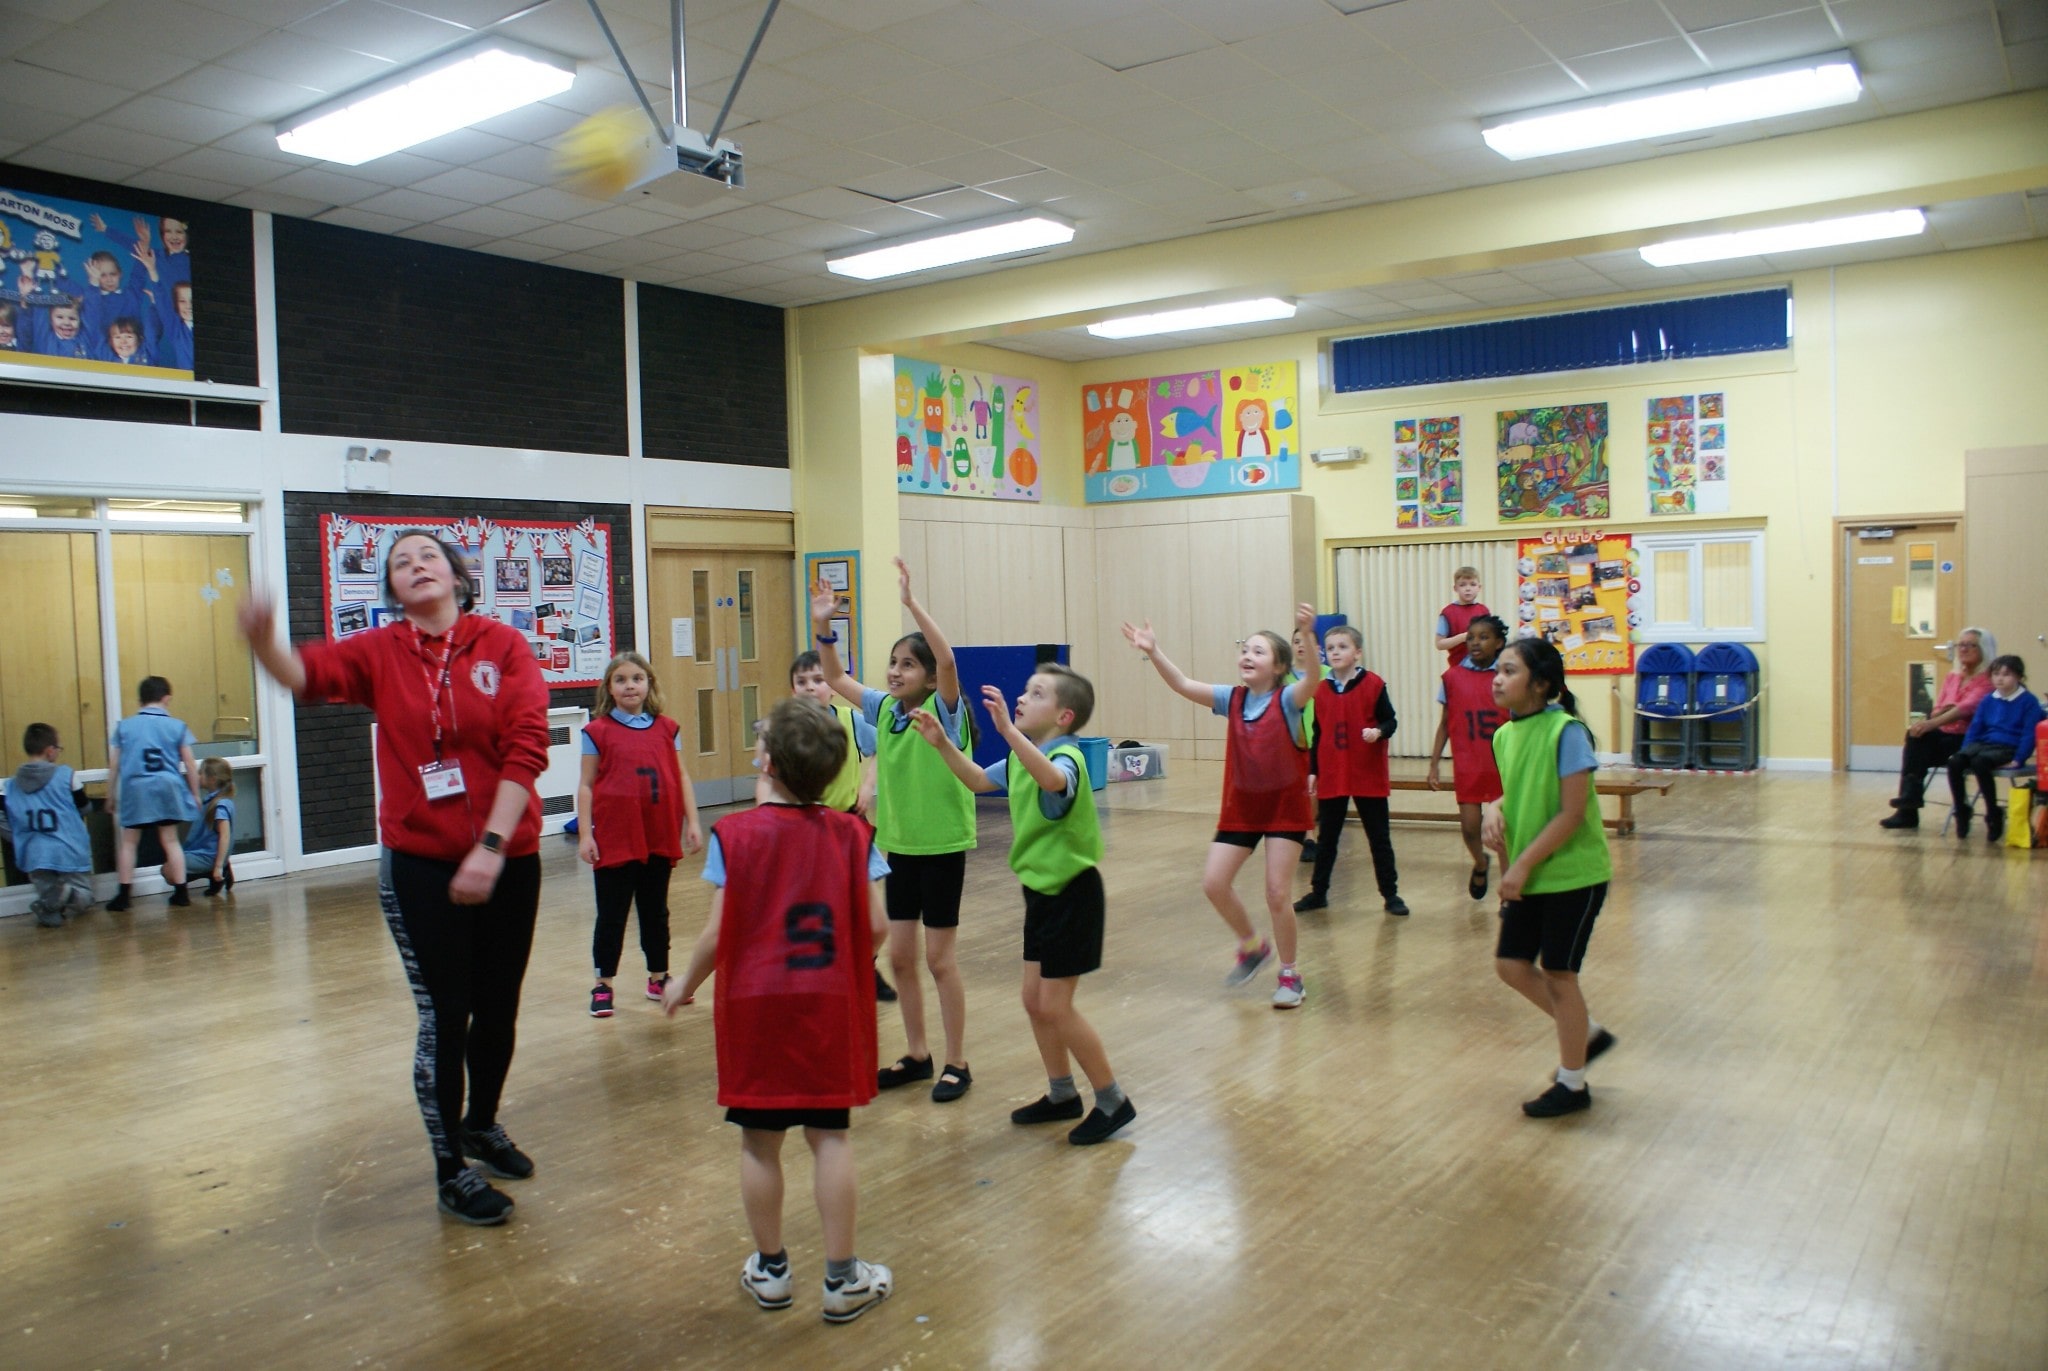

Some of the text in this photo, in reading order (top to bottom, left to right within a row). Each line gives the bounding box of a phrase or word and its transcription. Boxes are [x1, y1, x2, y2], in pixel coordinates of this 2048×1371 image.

[43, 211, 76, 230] MOSS
[1465, 710, 1498, 741] 15
[143, 748, 163, 772] 5
[636, 767, 658, 804] 7
[26, 808, 58, 832] 10
[785, 903, 835, 969] 9
